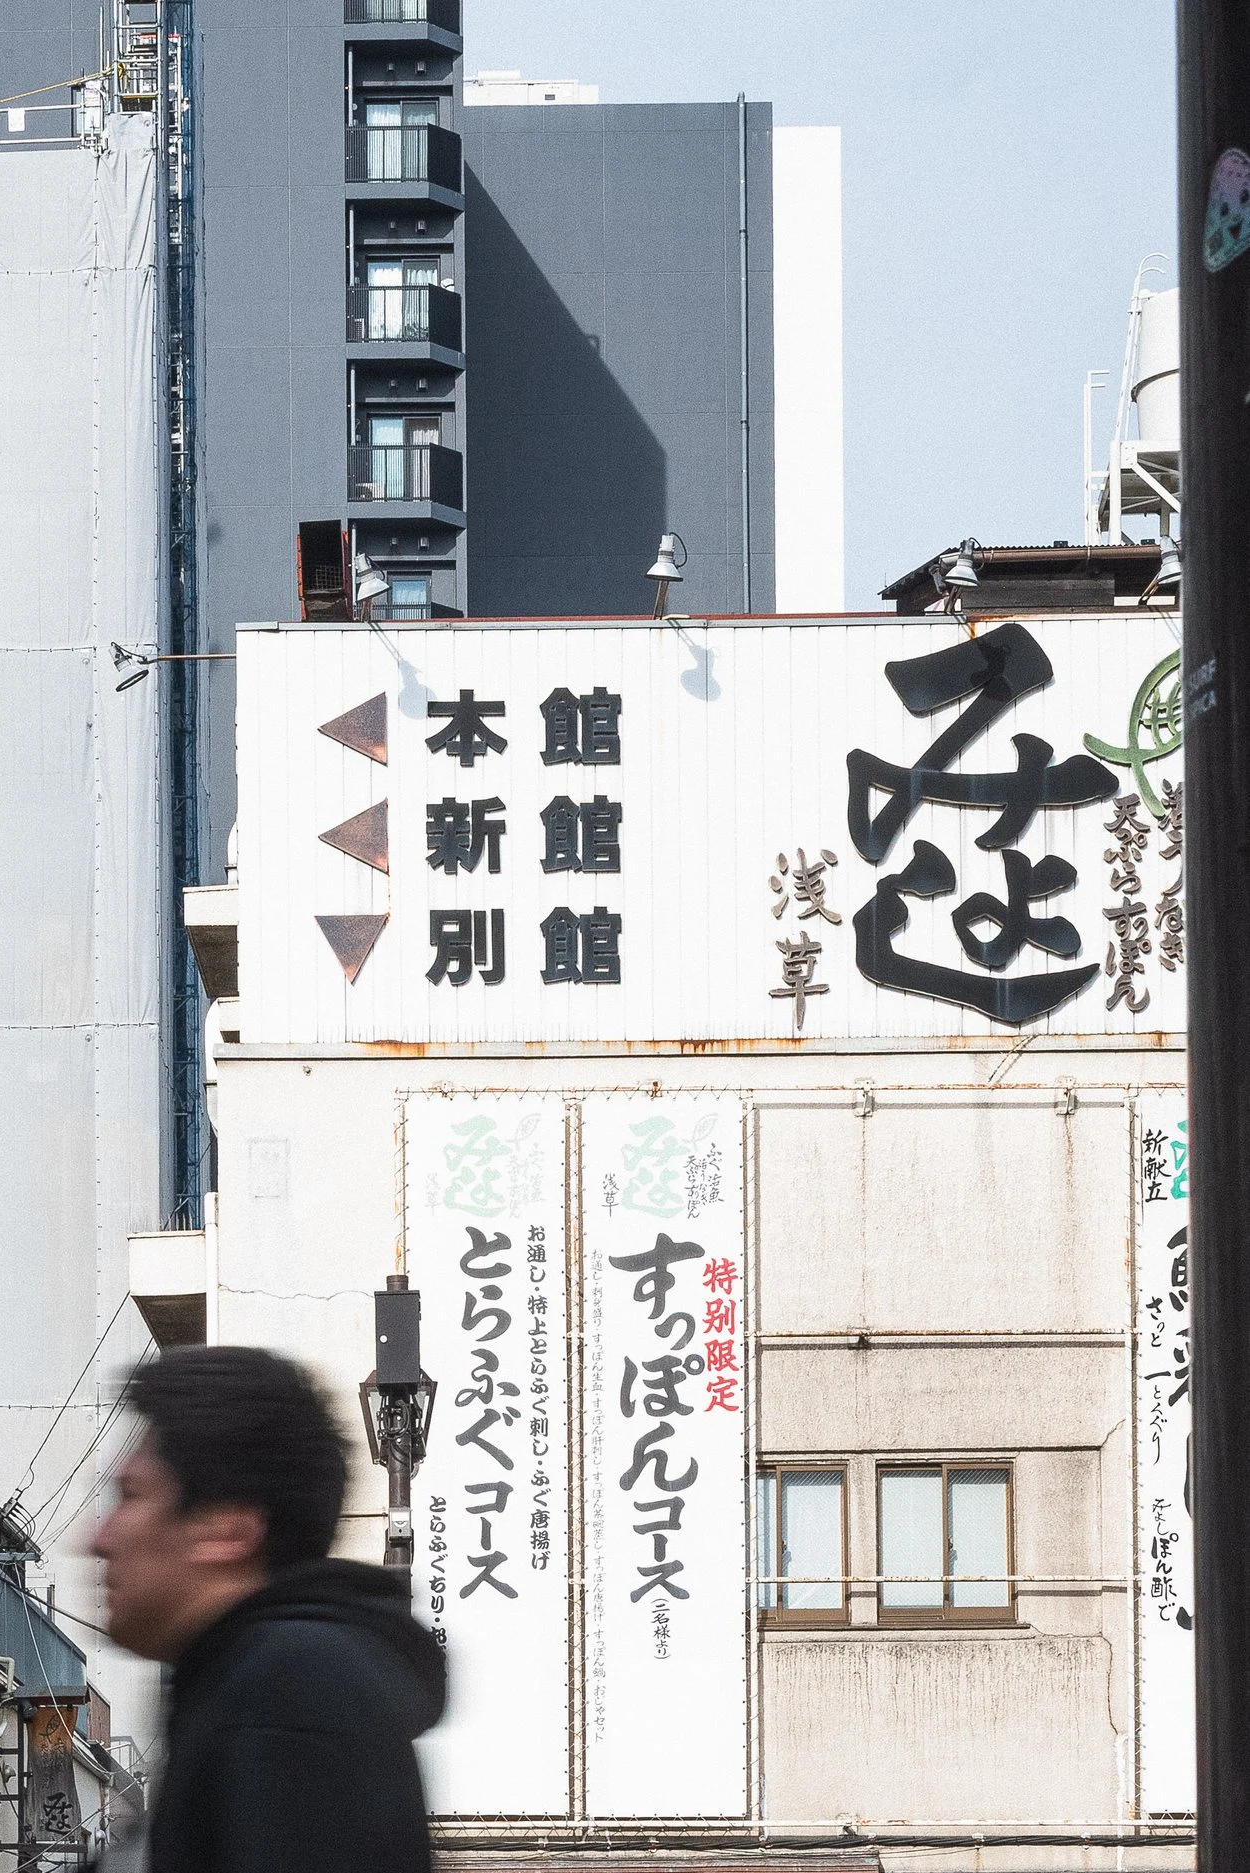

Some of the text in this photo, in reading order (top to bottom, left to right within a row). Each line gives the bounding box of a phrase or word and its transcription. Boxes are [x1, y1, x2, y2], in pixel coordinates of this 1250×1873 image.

[425, 686, 622, 767] 本館
[425, 795, 622, 873] 新館
[425, 906, 622, 985] 別館
[768, 848, 842, 1029] 浅草
[601, 1173, 619, 1217] 浅草
[702, 1258, 740, 1413] 特別限定
[454, 1226, 521, 1599] とらふぐコース
[609, 1233, 705, 1603] すっぽんコース
